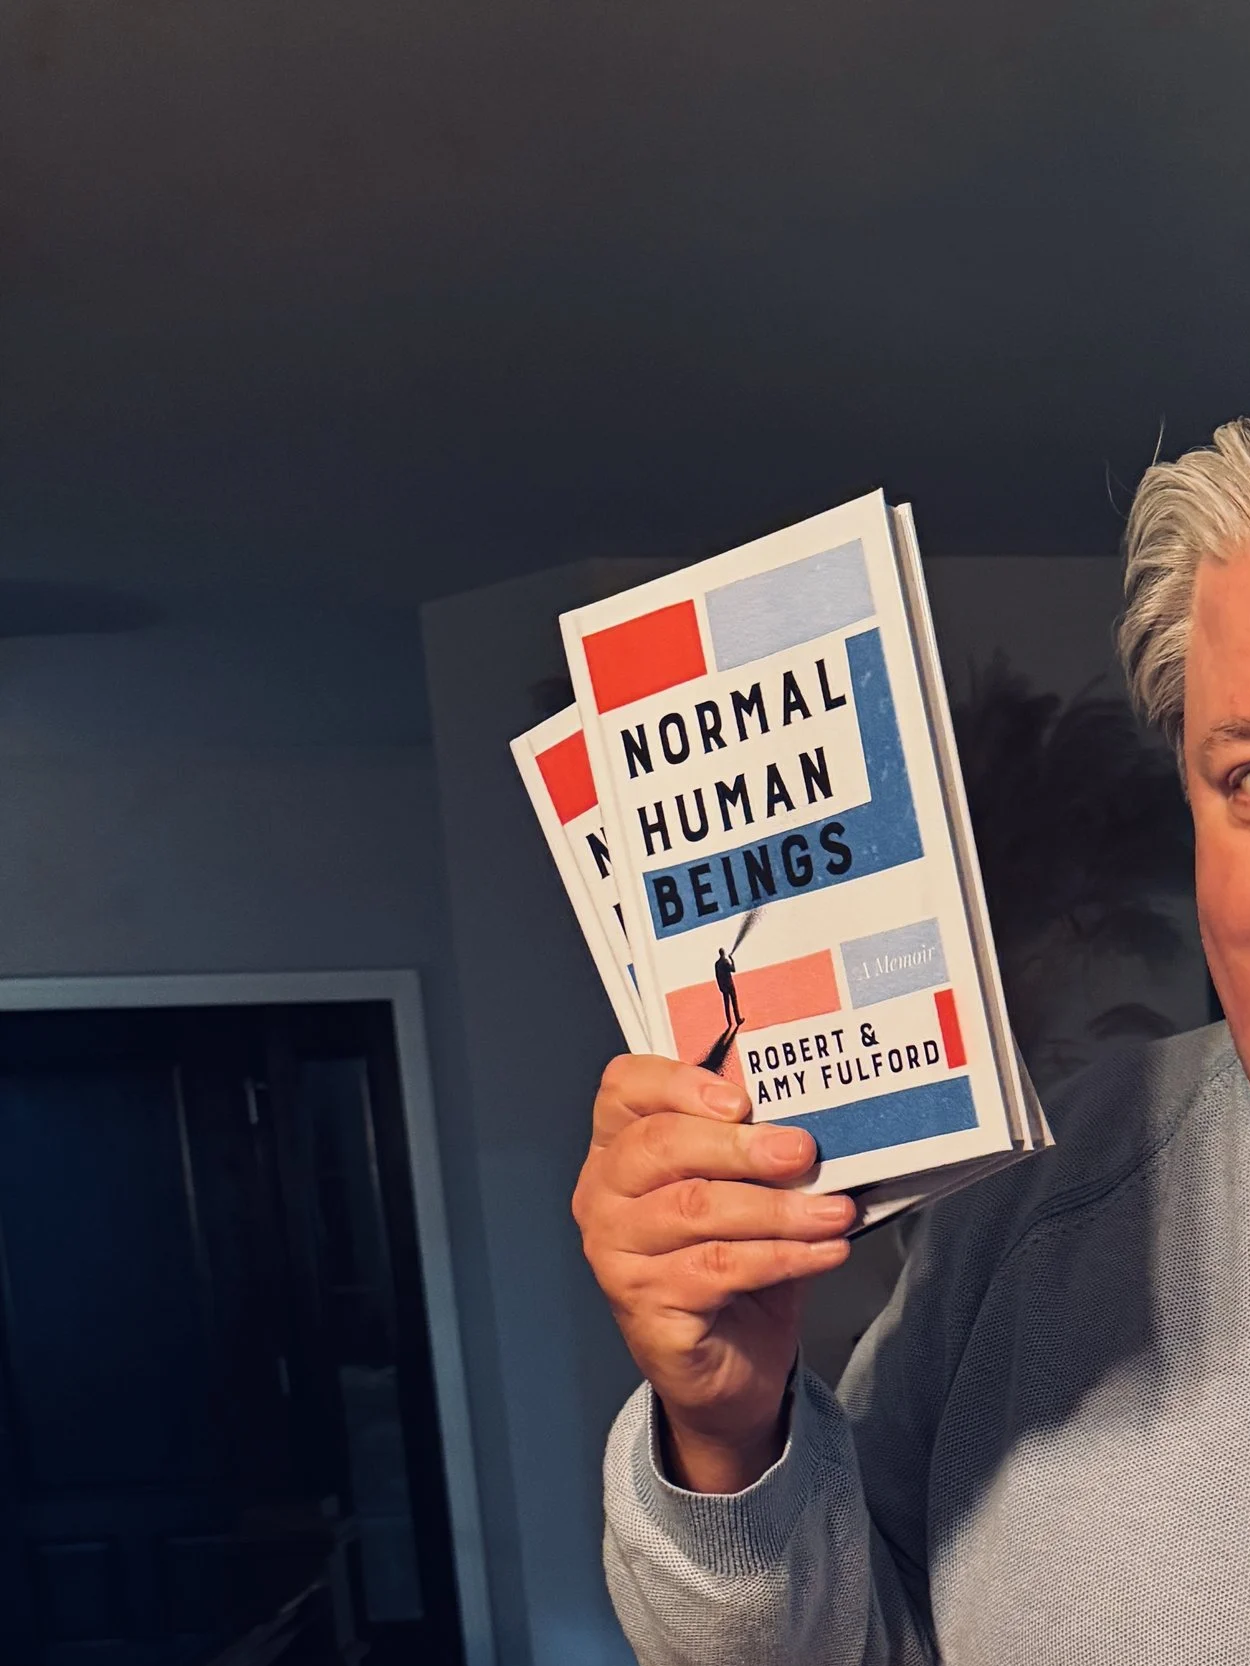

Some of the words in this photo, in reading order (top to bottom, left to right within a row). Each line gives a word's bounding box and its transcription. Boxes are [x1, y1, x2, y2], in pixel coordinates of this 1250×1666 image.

[619, 659, 848, 779] NORMAL
[637, 746, 835, 856] HUMAN
[651, 822, 853, 928] BEINGS
[859, 960, 873, 980] A
[874, 942, 935, 974] Memoir
[748, 1029, 845, 1073] ROBERT
[860, 1022, 878, 1047] &
[757, 1071, 808, 1104] AMY
[821, 1040, 940, 1090] FULFORD
